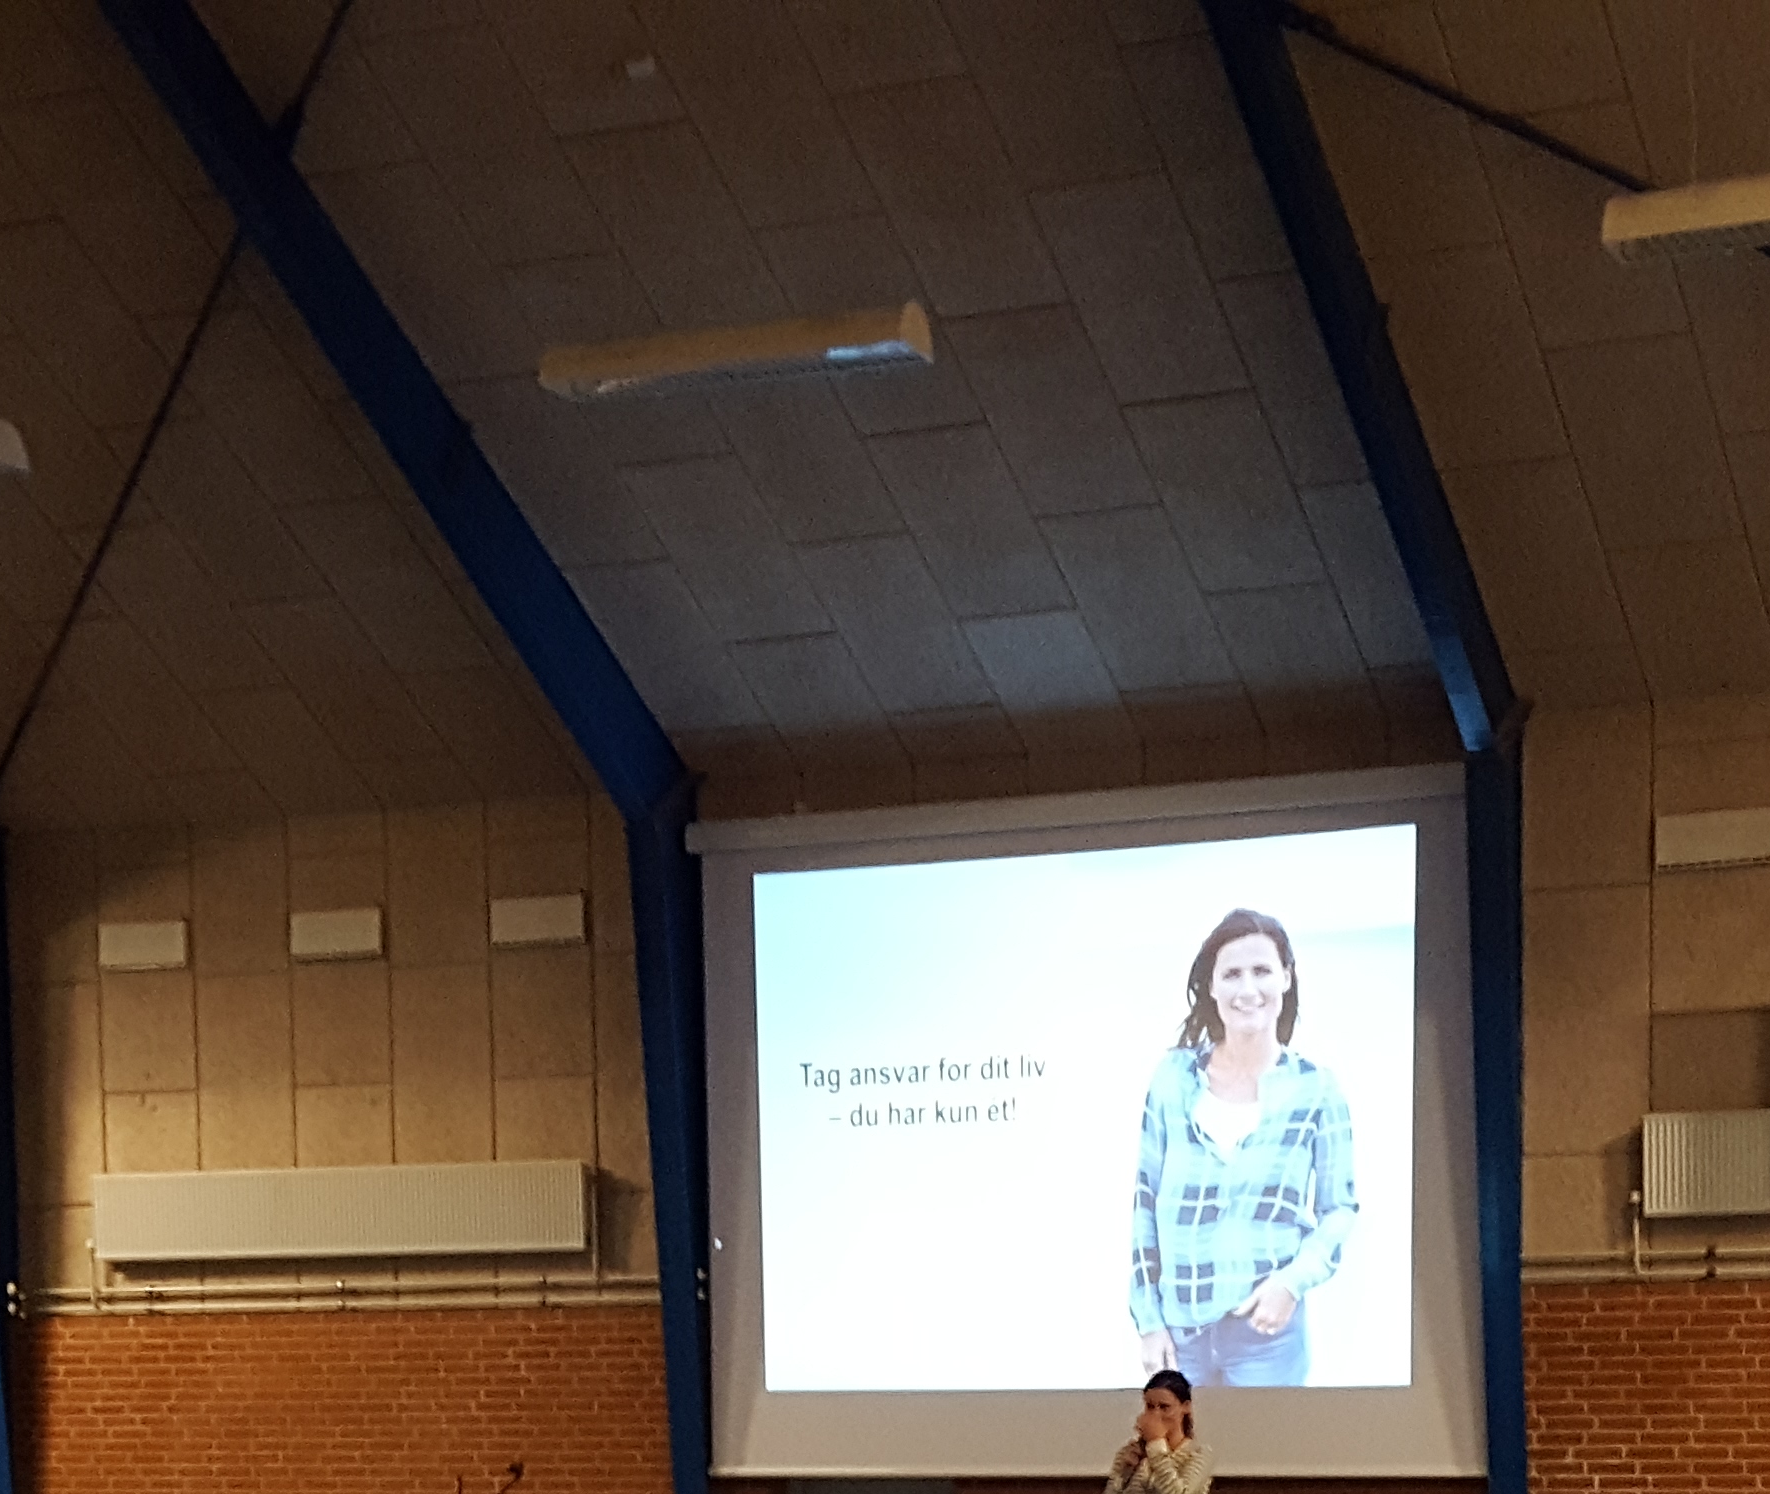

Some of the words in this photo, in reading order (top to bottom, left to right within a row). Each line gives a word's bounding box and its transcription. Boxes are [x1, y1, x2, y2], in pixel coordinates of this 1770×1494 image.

[798, 1061, 841, 1095] Tag
[849, 1064, 931, 1087] ansvar
[938, 1056, 972, 1083] for
[980, 1055, 1010, 1081] dit
[1020, 1054, 1046, 1079] liv
[849, 1102, 879, 1128] du
[888, 1101, 927, 1126] har
[934, 1099, 978, 1124] kun
